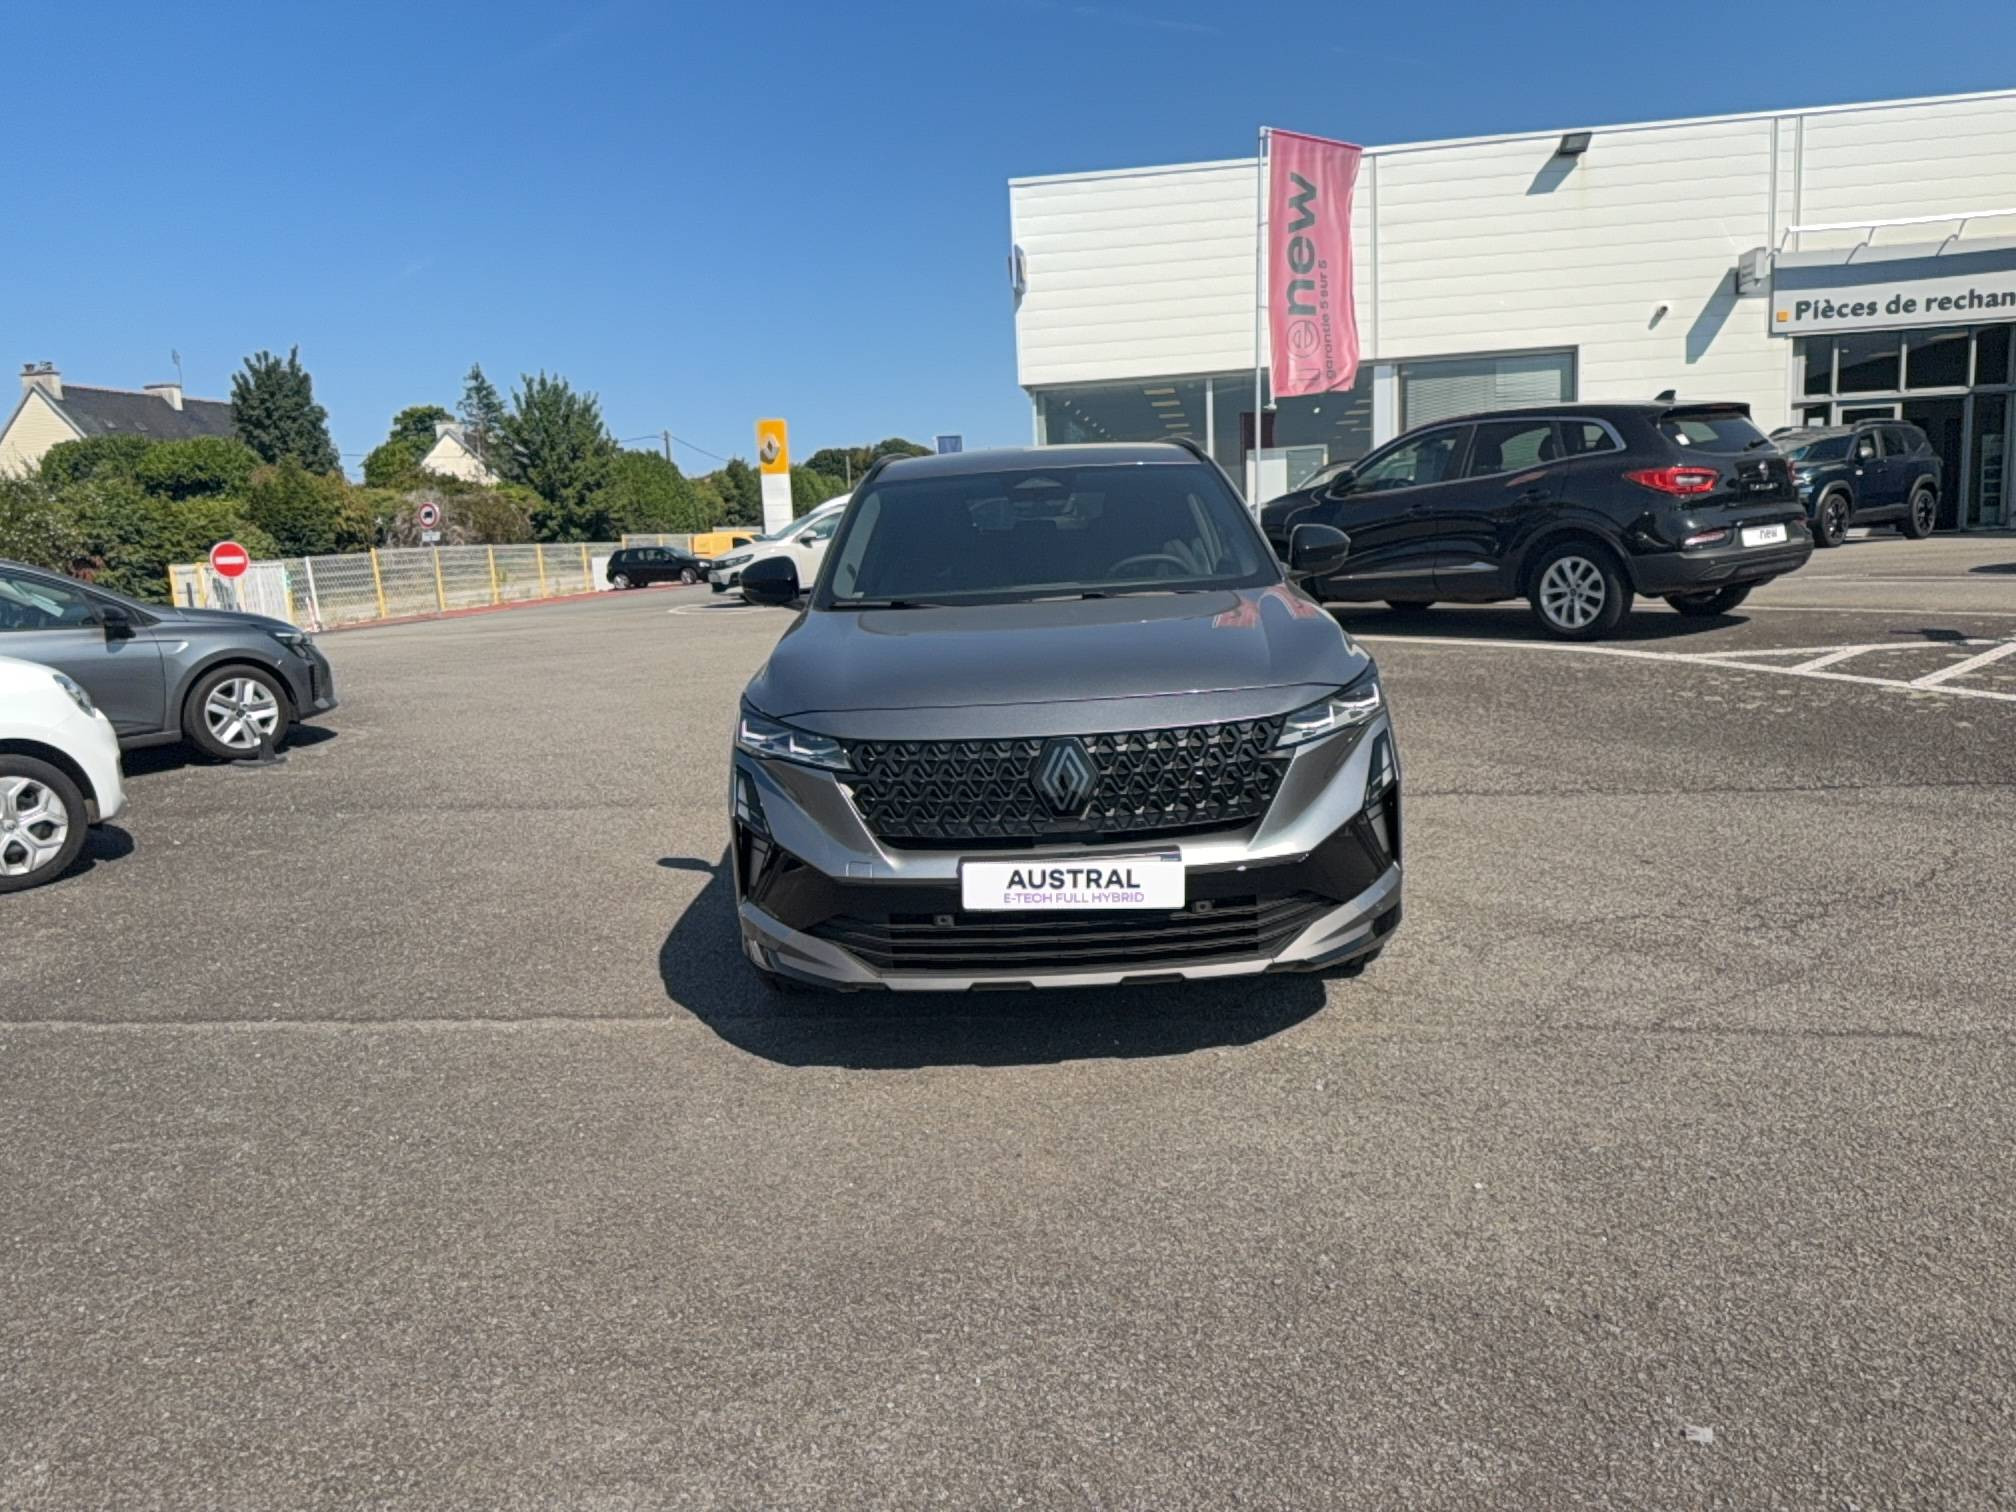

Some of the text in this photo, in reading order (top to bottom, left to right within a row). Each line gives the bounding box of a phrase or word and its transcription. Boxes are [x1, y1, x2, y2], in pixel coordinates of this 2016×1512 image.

[1320, 272, 1329, 298] sur
[1320, 299, 1329, 310] 5
[1795, 299, 1877, 320] Pièces
[1885, 294, 1917, 314] de
[1321, 314, 1336, 380] garantie
[1006, 868, 1140, 889] AUSTRAL
[1003, 892, 1145, 904] E-TECH FULL HYBRID
